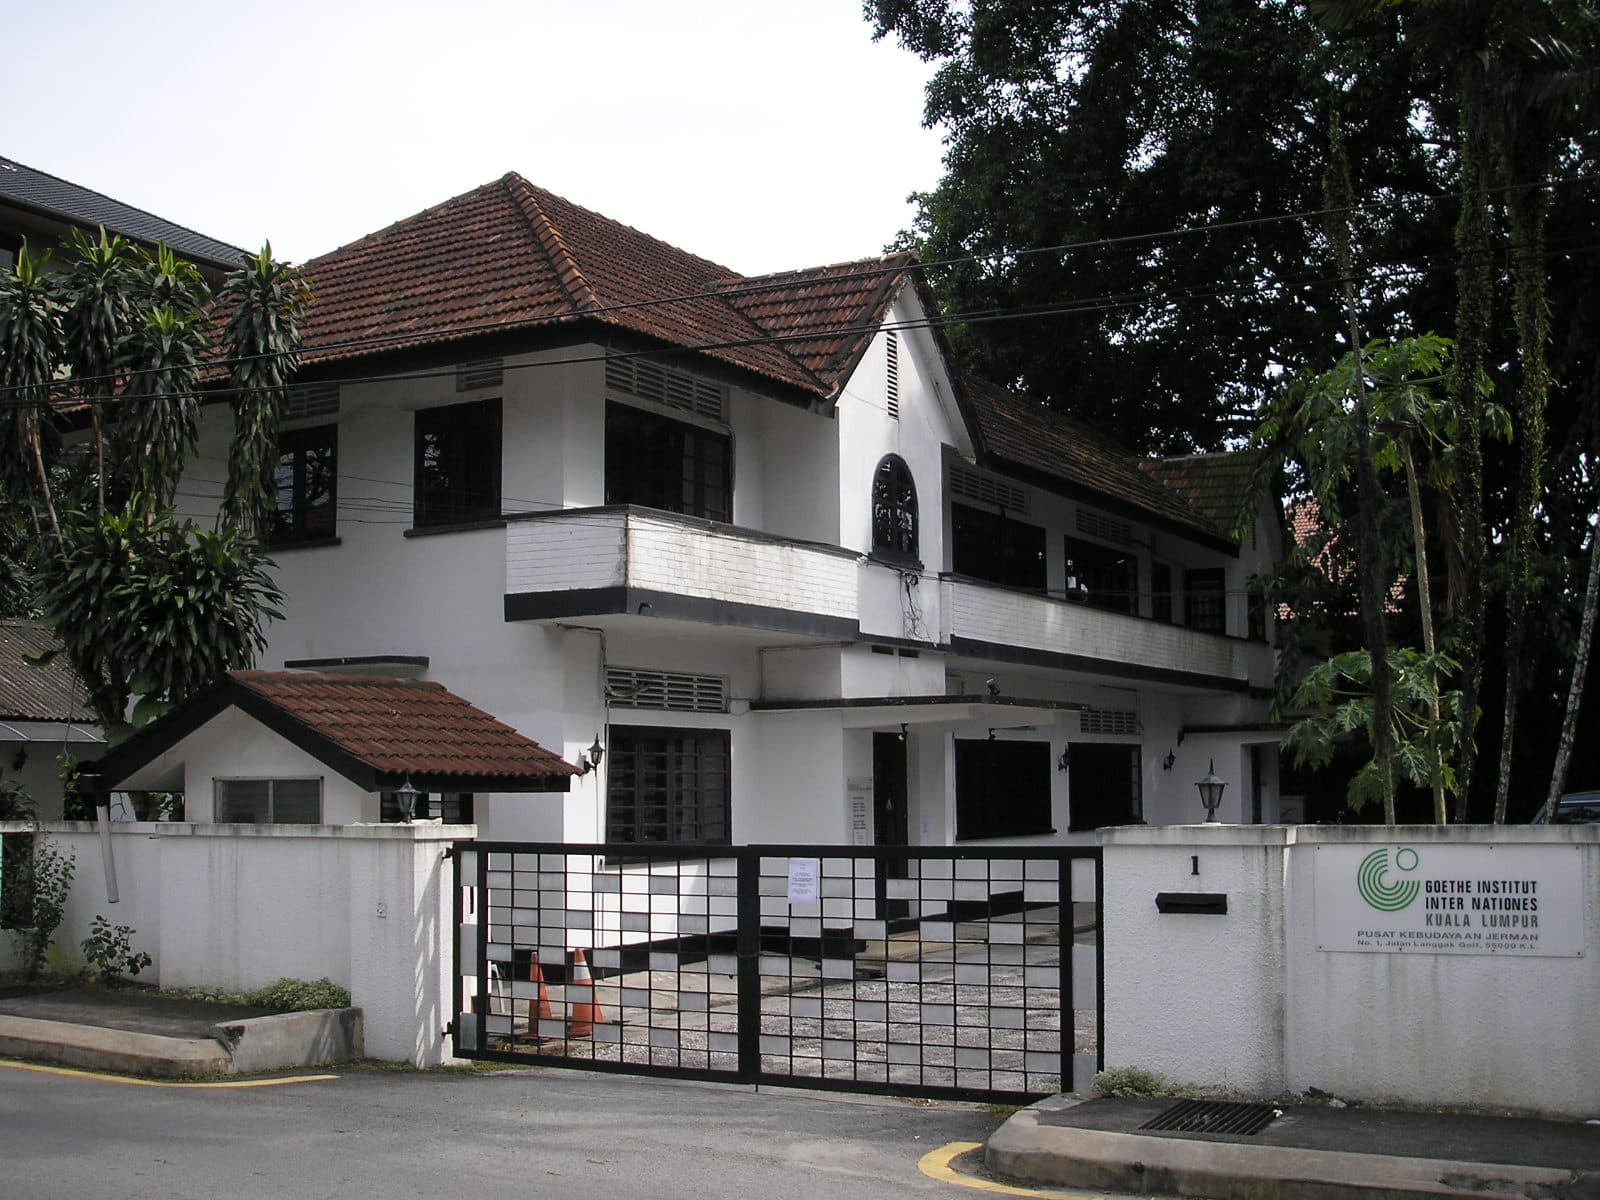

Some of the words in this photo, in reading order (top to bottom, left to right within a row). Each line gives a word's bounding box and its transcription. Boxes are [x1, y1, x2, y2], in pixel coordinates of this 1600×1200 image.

[1190, 855, 1200, 875] 1
[1425, 880, 1472, 894] GOETHE
[1477, 880, 1537, 894] INSTITUT
[1425, 897, 1464, 910] INTER
[1471, 897, 1538, 911] NATIONES
[1425, 913, 1471, 927] KUALA
[1482, 914, 1539, 928] LUMPUR
[1357, 930, 1396, 938] PUSAT
[1399, 931, 1482, 940] KEBUDAYAAN
[1485, 933, 1539, 941] JERMAN
[1413, 941, 1455, 949] Langgak
